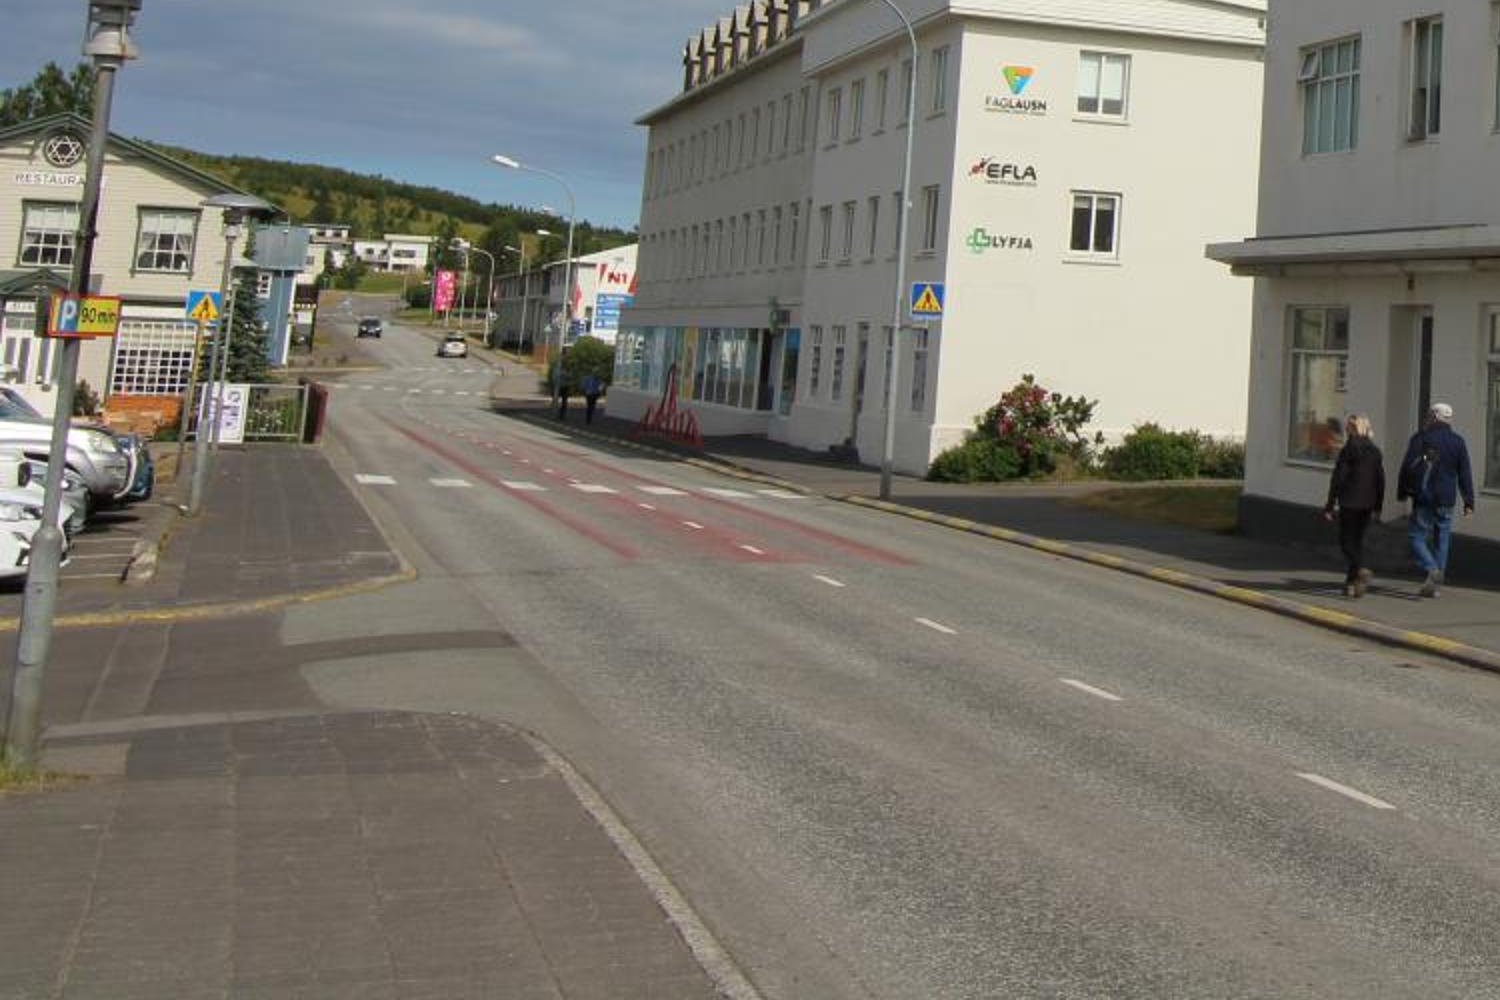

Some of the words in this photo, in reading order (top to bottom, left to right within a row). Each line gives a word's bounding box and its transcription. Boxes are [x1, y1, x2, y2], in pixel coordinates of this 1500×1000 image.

[986, 163, 1036, 181] EFLA
[992, 235, 1032, 249] LYFJA
[607, 271, 627, 284] N1
[60, 299, 77, 330] P
